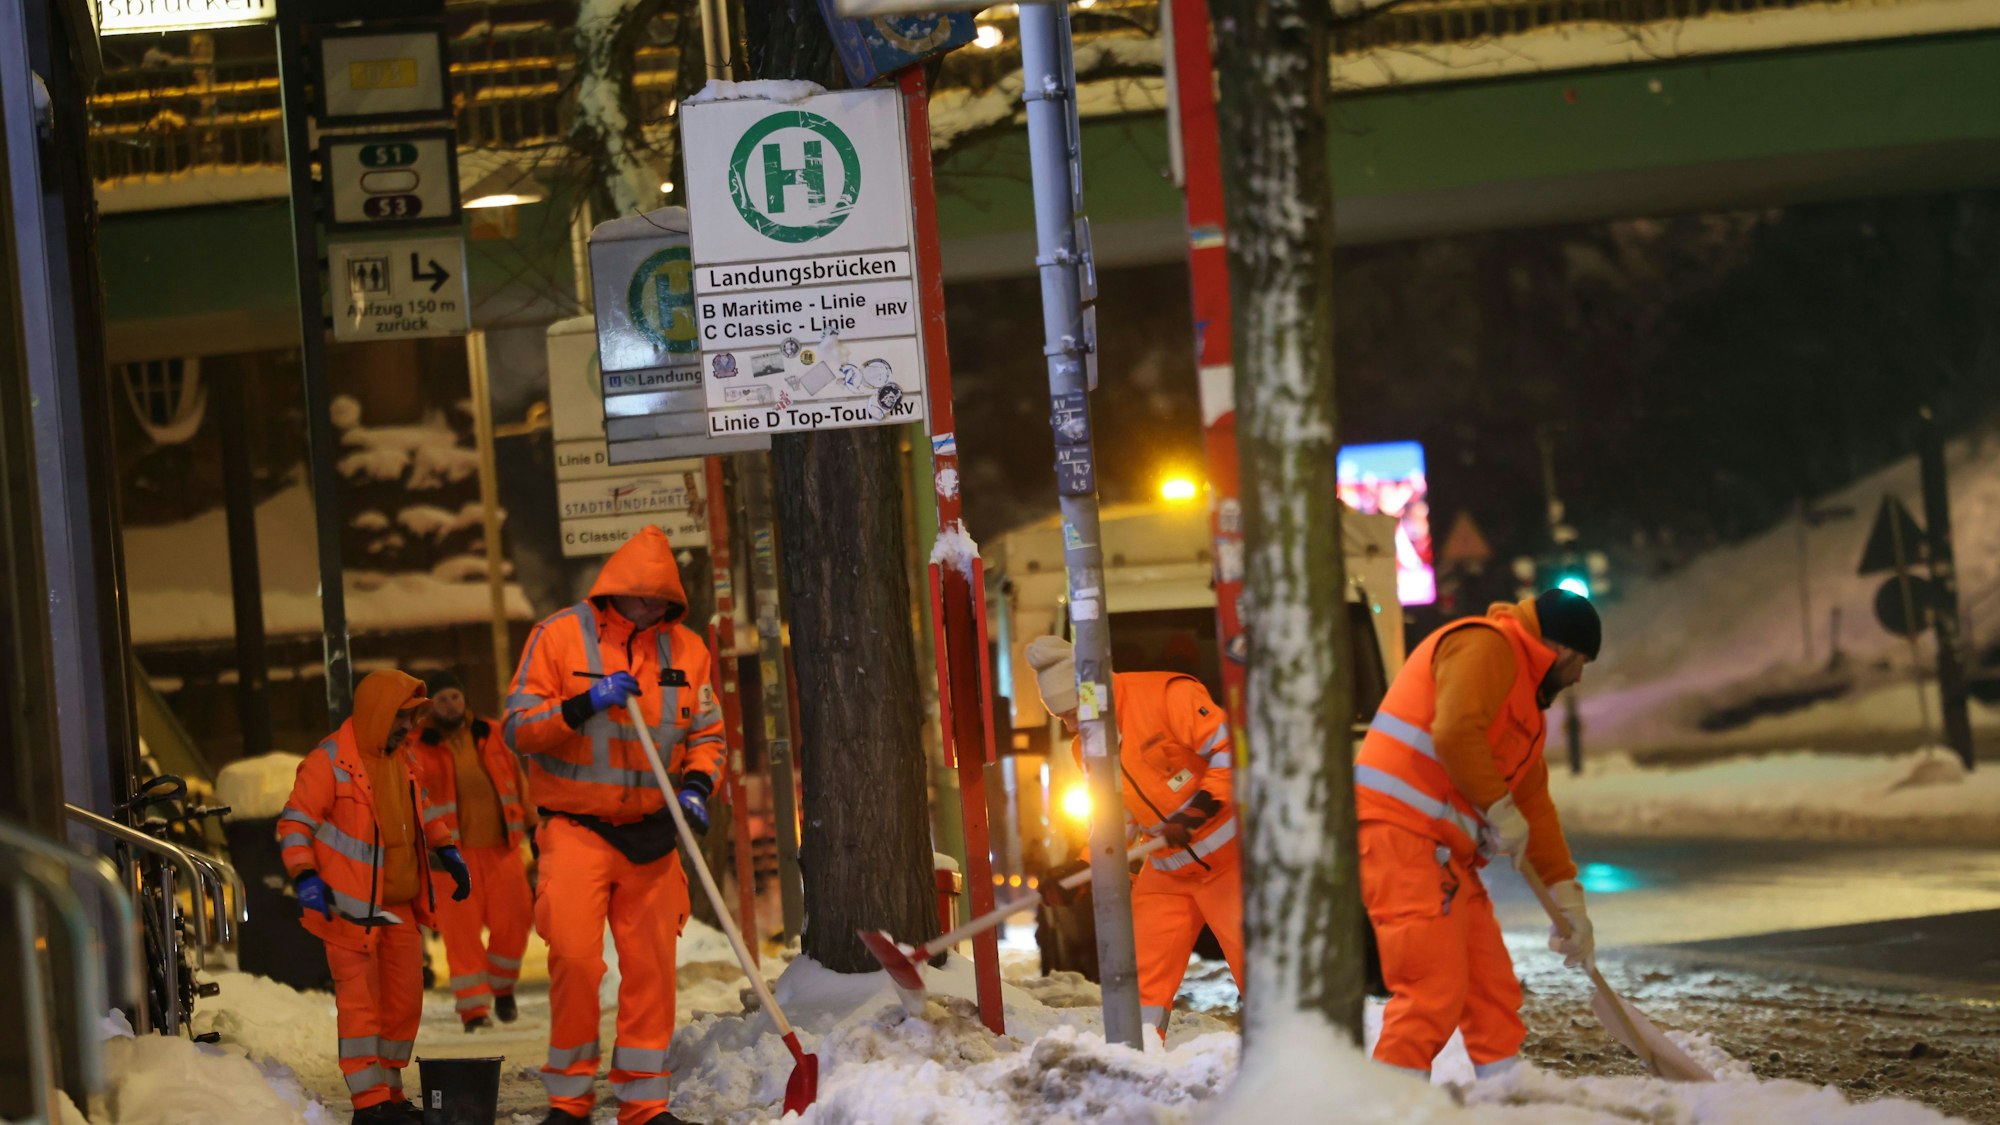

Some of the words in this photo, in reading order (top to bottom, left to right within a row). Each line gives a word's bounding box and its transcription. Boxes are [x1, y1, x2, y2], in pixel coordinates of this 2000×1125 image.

[762, 140, 826, 214] H
[710, 257, 896, 287] Landungsbrücken
[408, 299, 437, 315] 150
[440, 301, 455, 312] m
[703, 304, 716, 319] B
[722, 299, 802, 318] Maritime
[821, 293, 866, 310] Linie
[875, 301, 908, 316] HRV
[376, 317, 428, 333] zurück
[704, 325, 717, 340] C
[724, 320, 793, 339] Classic
[810, 315, 856, 332] Linie
[889, 402, 914, 416] RV
[712, 415, 760, 432] Linie
[767, 412, 781, 427] D
[559, 454, 591, 467] Linie
[595, 453, 605, 465] D
[1071, 480, 1087, 491] 4,5
[565, 533, 575, 545] C
[579, 529, 629, 544] Classic
